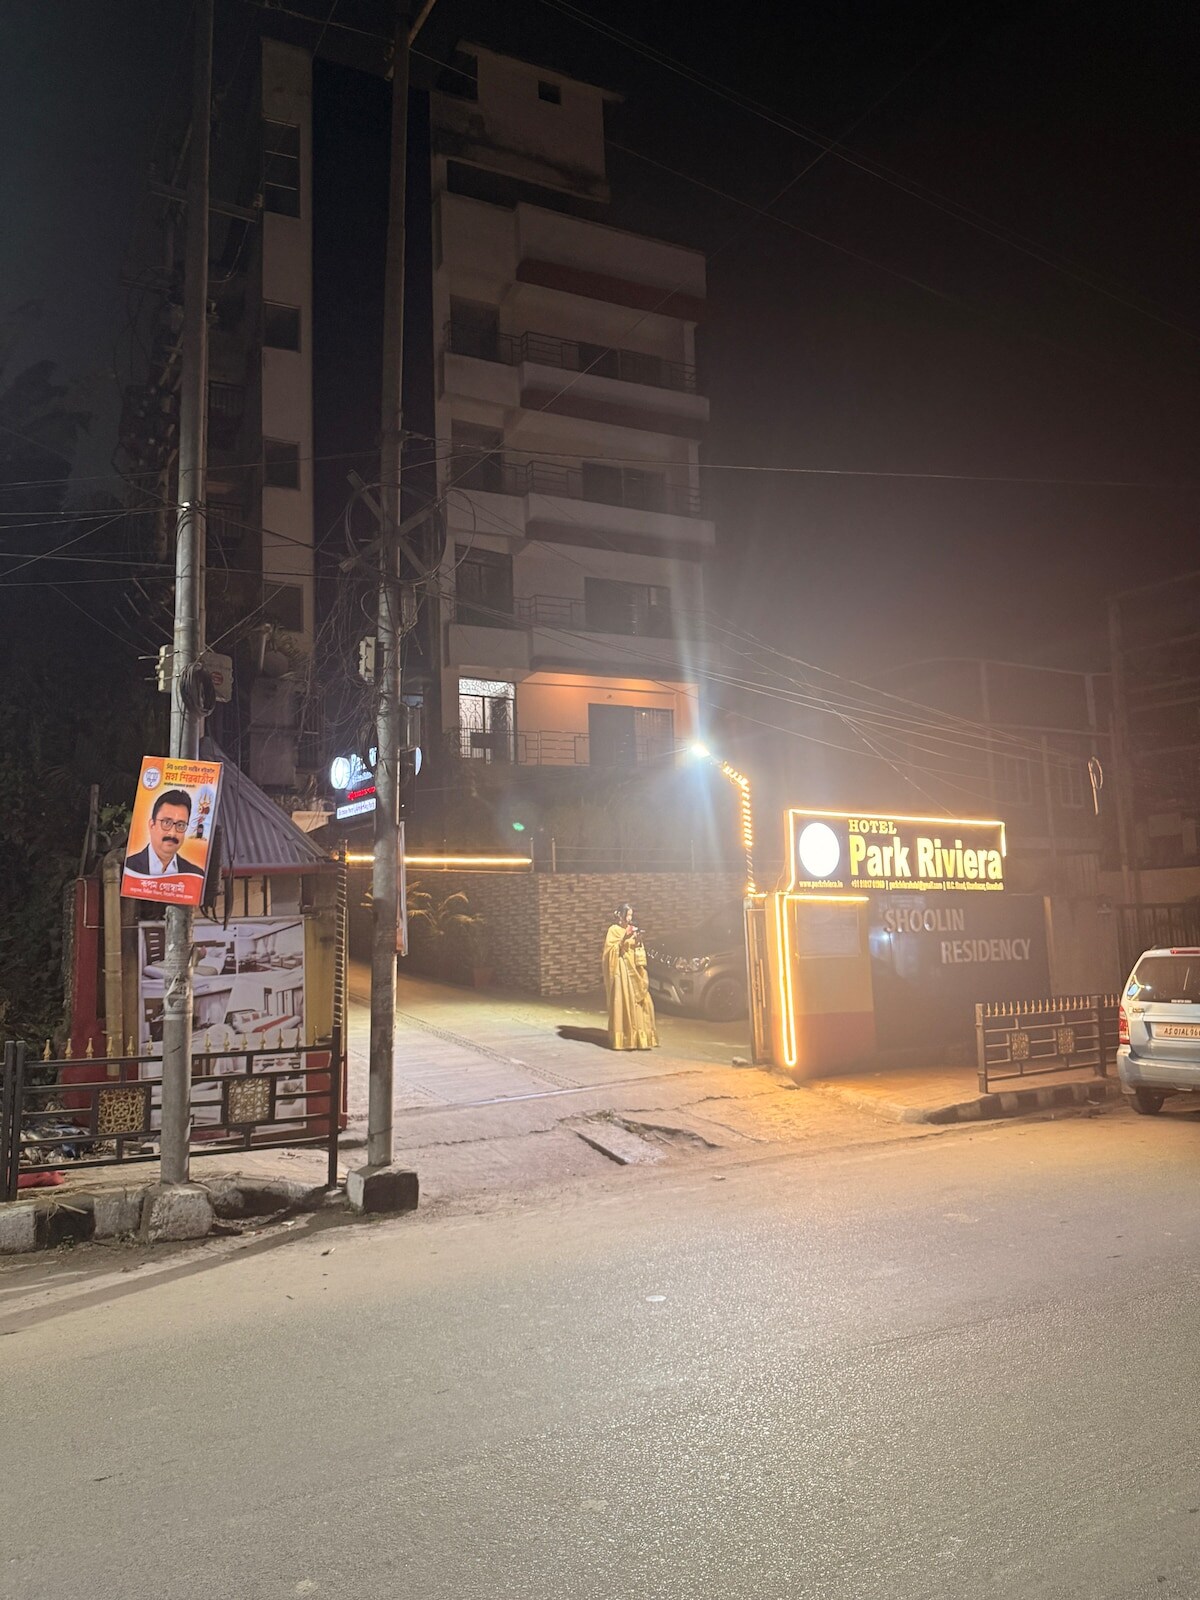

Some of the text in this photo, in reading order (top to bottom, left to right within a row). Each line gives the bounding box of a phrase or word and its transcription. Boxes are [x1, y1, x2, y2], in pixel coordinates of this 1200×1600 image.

[848, 819, 897, 835] HOTEL
[849, 834, 1004, 880] Park Riviera
[884, 908, 965, 932] SHOOLIN
[941, 938, 1031, 964] RESIDENCY
